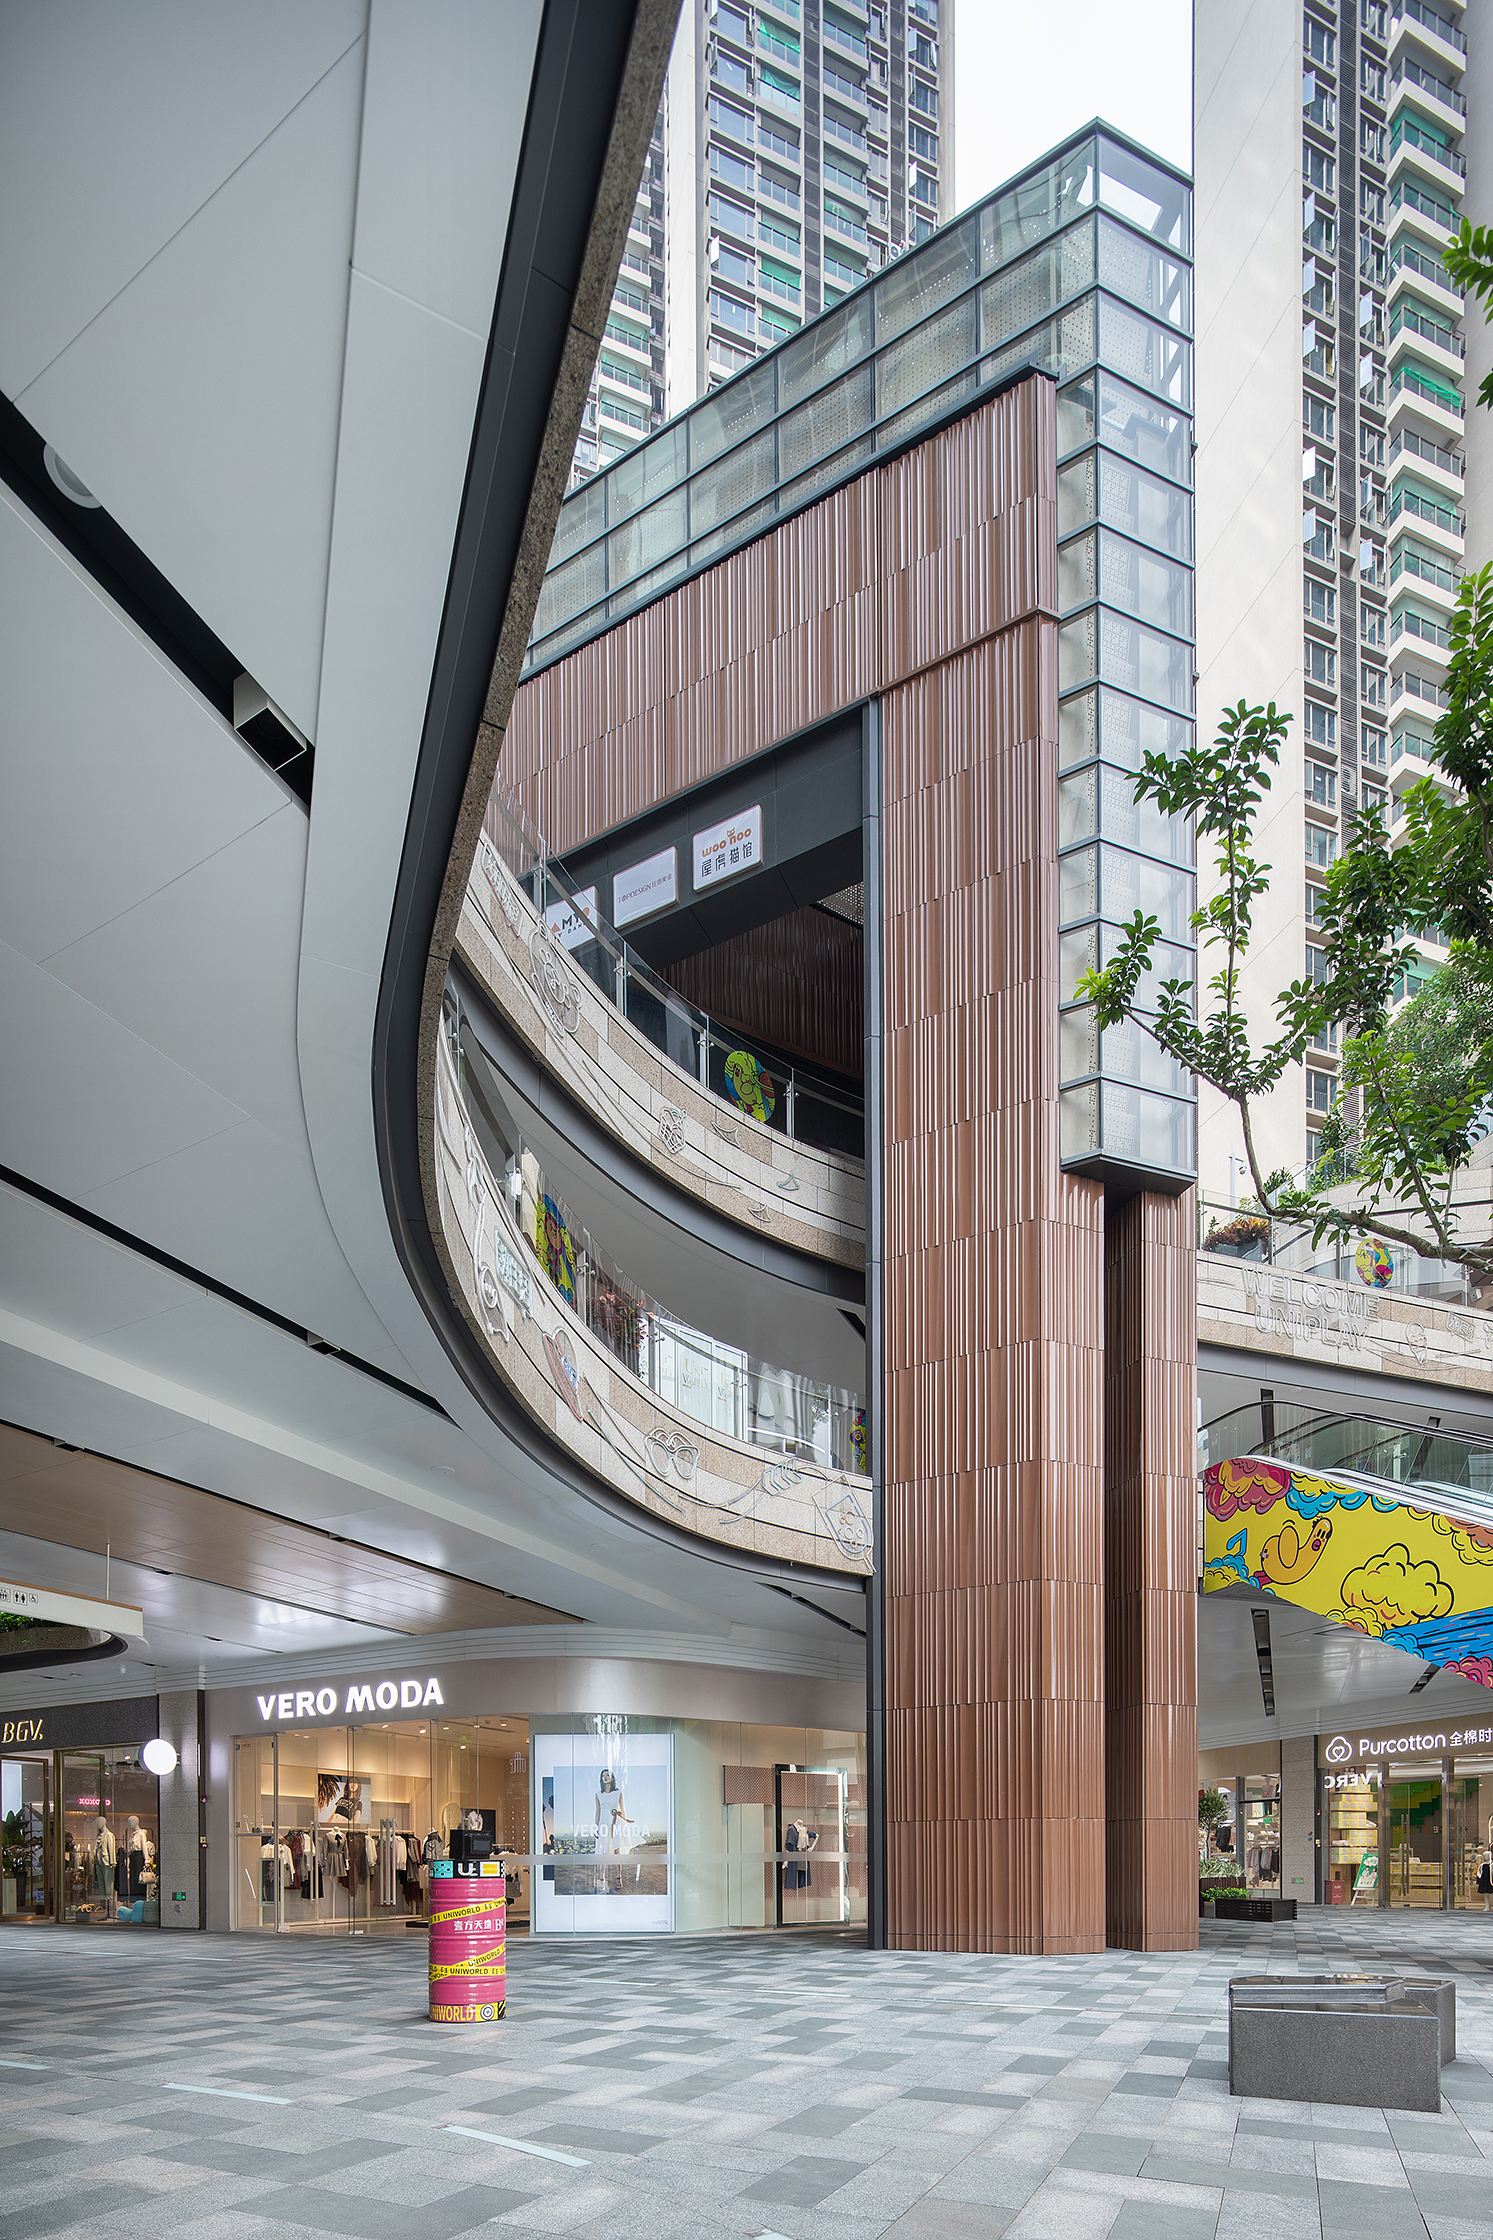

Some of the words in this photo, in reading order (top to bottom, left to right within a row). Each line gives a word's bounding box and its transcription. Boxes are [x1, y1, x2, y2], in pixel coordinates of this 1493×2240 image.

[702, 840, 727, 857] woo
[1242, 1268, 1379, 1321] WELCOME
[1255, 1304, 1368, 1351] UNIPLAY
[257, 1687, 337, 1721] VERO
[344, 1677, 444, 1713] MODA
[1359, 1734, 1447, 1757] Purcotton
[1449, 1727, 1493, 1747] 全棉时
[570, 1824, 609, 1838] VERO
[613, 1824, 651, 1838] MODA
[443, 1906, 481, 1920] UNIWORLD
[468, 1948, 501, 1967] UNIWORLD
